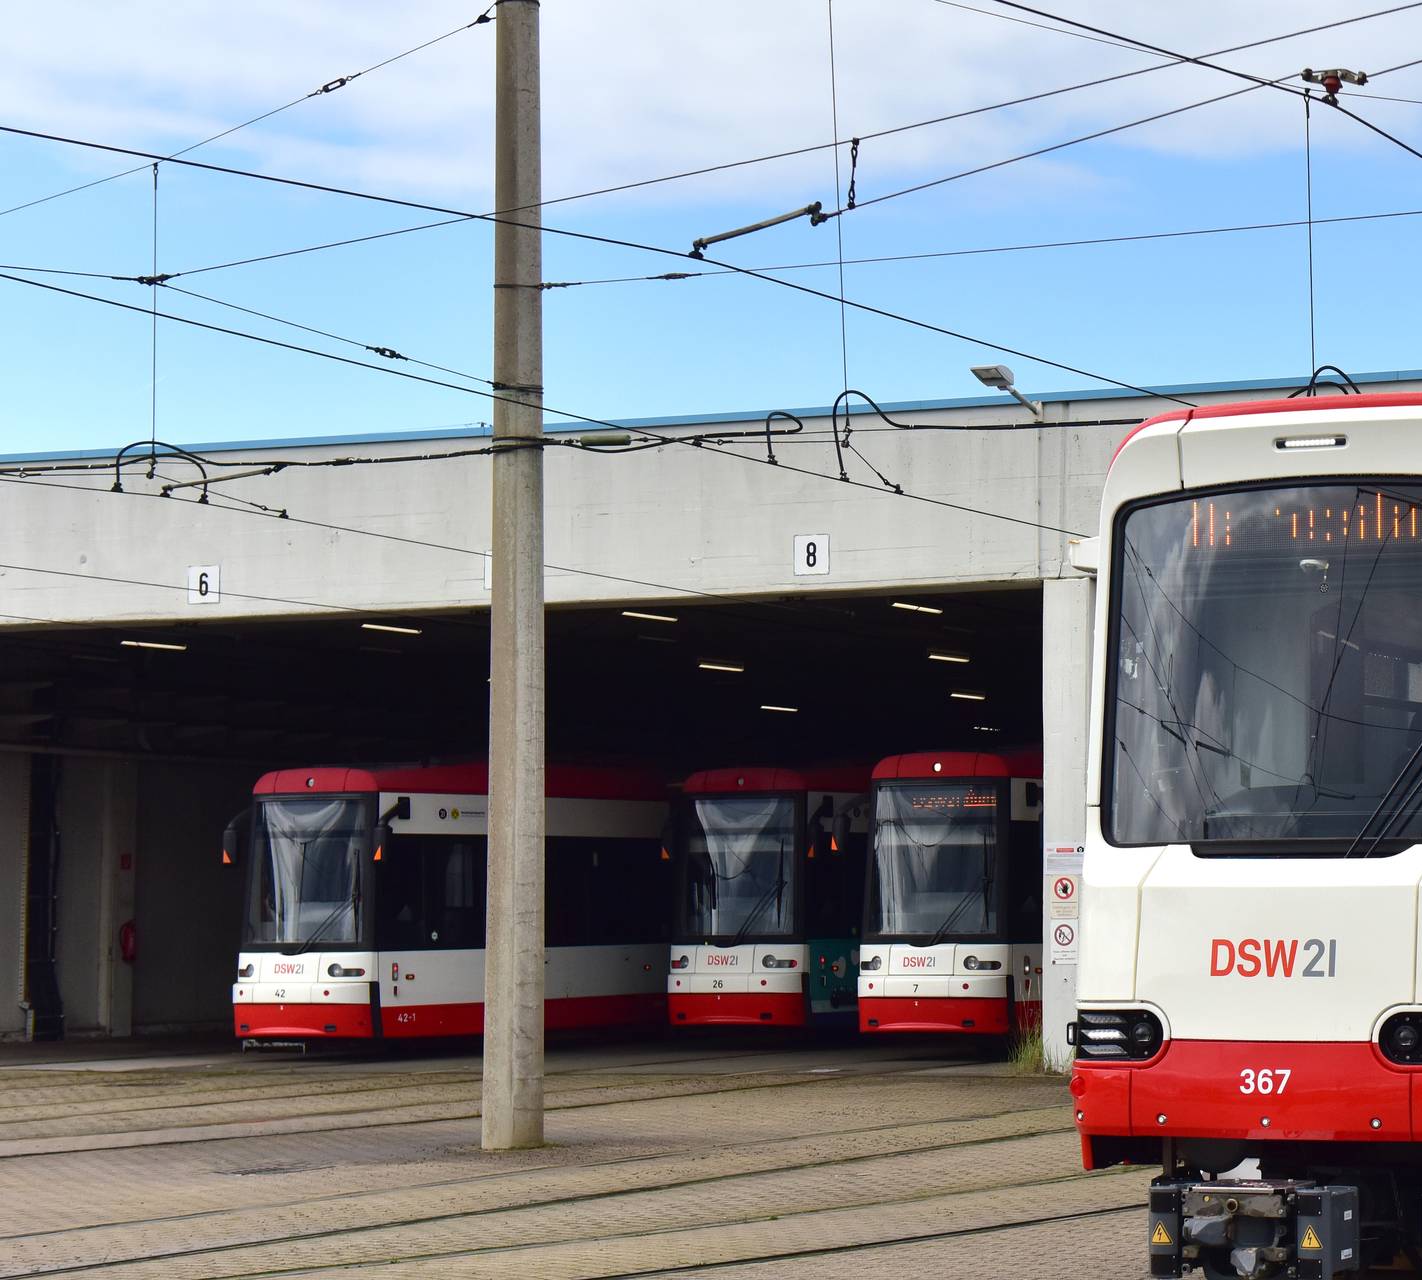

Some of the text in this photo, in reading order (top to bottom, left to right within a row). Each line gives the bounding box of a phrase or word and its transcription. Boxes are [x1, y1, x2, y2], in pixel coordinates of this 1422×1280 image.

[806, 541, 817, 568] 8
[199, 572, 209, 597] 6
[707, 954, 738, 966] DSW21
[902, 956, 936, 967] DSW21
[1210, 939, 1337, 978] DSW21
[273, 963, 304, 975] DSW21
[712, 979, 723, 989] 26
[913, 983, 919, 993] 7
[274, 989, 286, 999] 42
[397, 1012, 416, 1023] 42-1
[1239, 1068, 1292, 1095] 367
